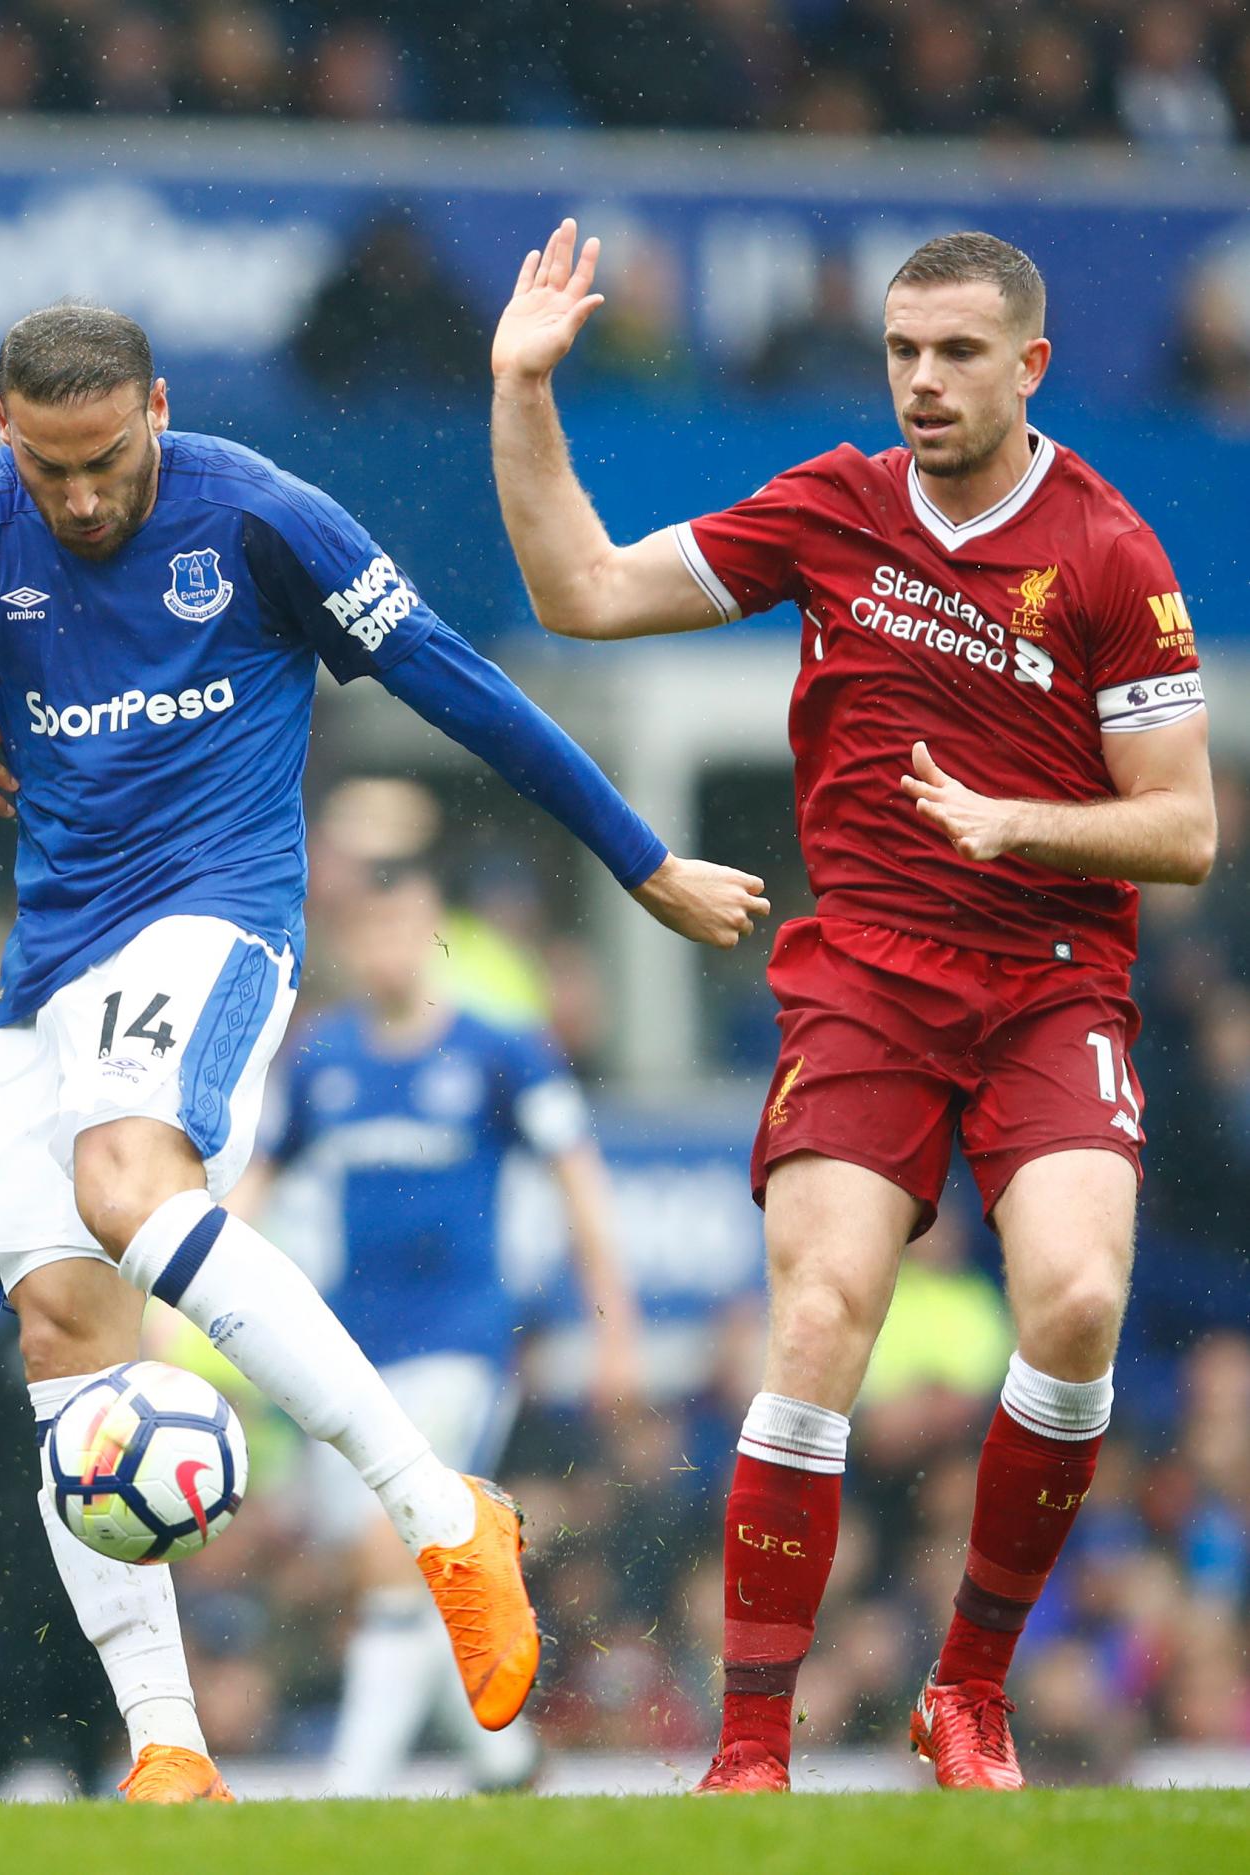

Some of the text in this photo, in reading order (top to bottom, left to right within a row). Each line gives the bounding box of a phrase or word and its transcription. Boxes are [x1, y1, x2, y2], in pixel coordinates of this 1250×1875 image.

[180, 589, 217, 600] Everton
[322, 551, 398, 629] ANGRY
[6, 607, 46, 620] umbro
[850, 597, 1008, 673] Chartered
[1022, 628, 1044, 637] YEARS
[25, 677, 235, 737] SportPesa
[98, 990, 178, 1059] 14
[738, 1524, 806, 1557] L.F.C.
